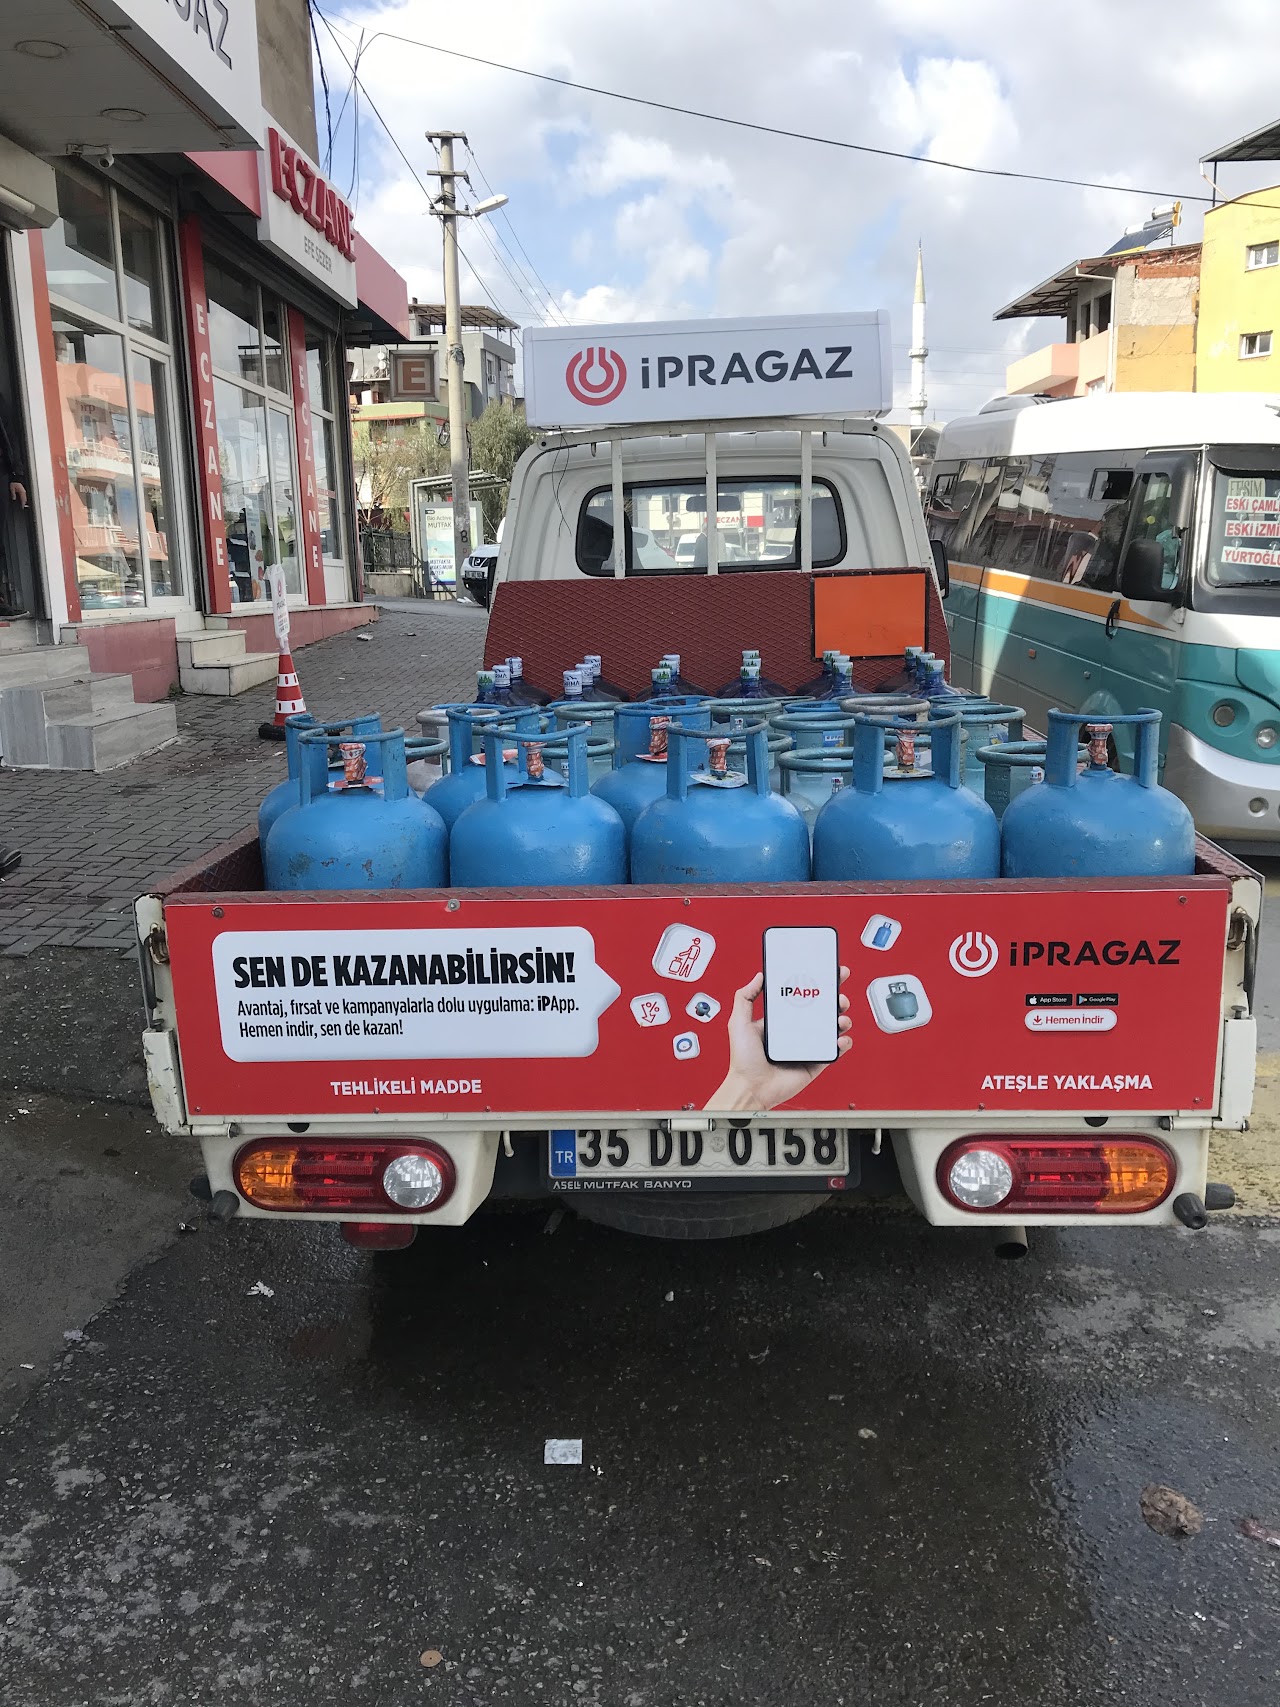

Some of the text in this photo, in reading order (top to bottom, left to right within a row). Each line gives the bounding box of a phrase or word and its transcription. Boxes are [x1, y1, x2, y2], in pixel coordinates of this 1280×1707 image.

[268, 127, 357, 263] ECZANE
[304, 236, 333, 273] EFE SEZER
[403, 361, 425, 390] E
[196, 303, 225, 566] ECZANE
[298, 365, 319, 568] ECZANE
[232, 946, 576, 988] SEN DE KAZANABİLİRSİN!
[780, 987, 820, 999] iPApp
[1089, 996, 1105, 1004] Google
[237, 995, 579, 1019] Avantaj, fırsat ve kampanyalarla dolu uygulama: iPApp.
[239, 1020, 403, 1040] Hemen indir, sen de kazan!
[1045, 1014, 1104, 1024] Hemen İndir
[330, 1077, 482, 1096] TEHLİKELİ MADDE
[981, 1075, 1153, 1093] ATEŞLE YAKLAŞMA
[555, 1150, 574, 1164] TR
[578, 1128, 838, 1168] 35 DD 0158
[584, 1181, 639, 1189] MUTFAK
[643, 1180, 692, 1189] BANYO
